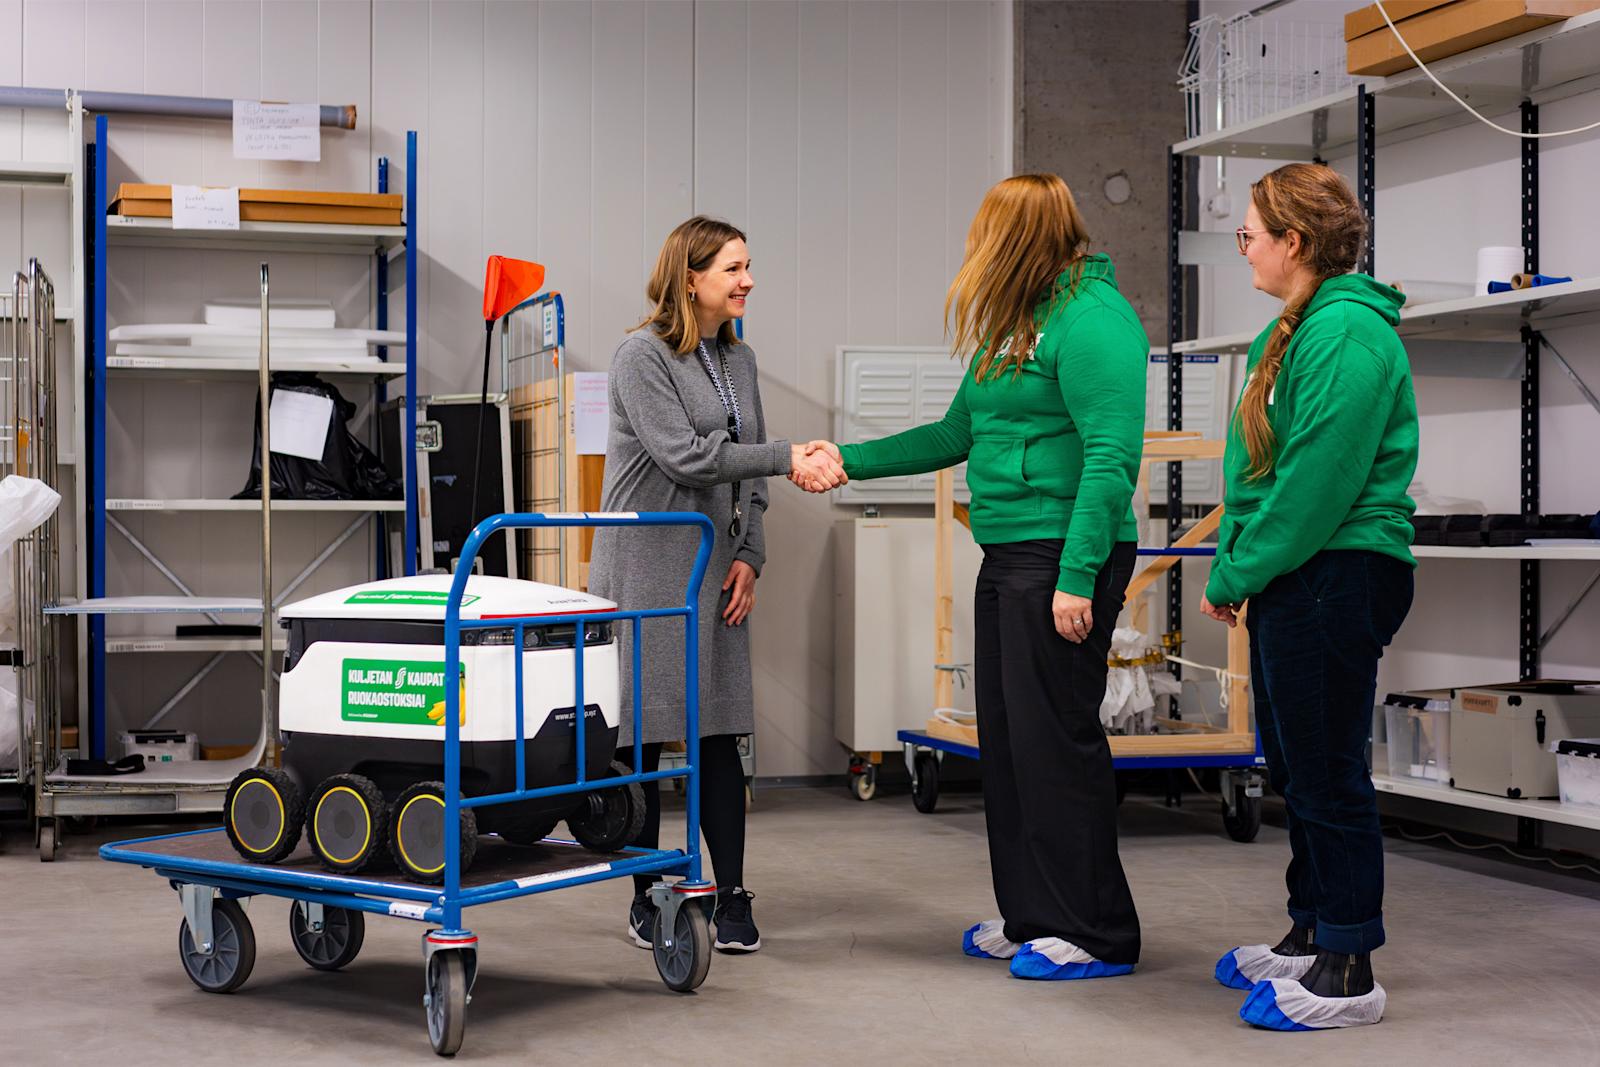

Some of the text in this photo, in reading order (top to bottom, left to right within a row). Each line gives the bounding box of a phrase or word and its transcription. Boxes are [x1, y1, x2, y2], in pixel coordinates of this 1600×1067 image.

[348, 669, 393, 685] KULJETAN
[407, 671, 445, 687] KAUPAT
[347, 690, 426, 708] RUOKAOSTOKSIA!
